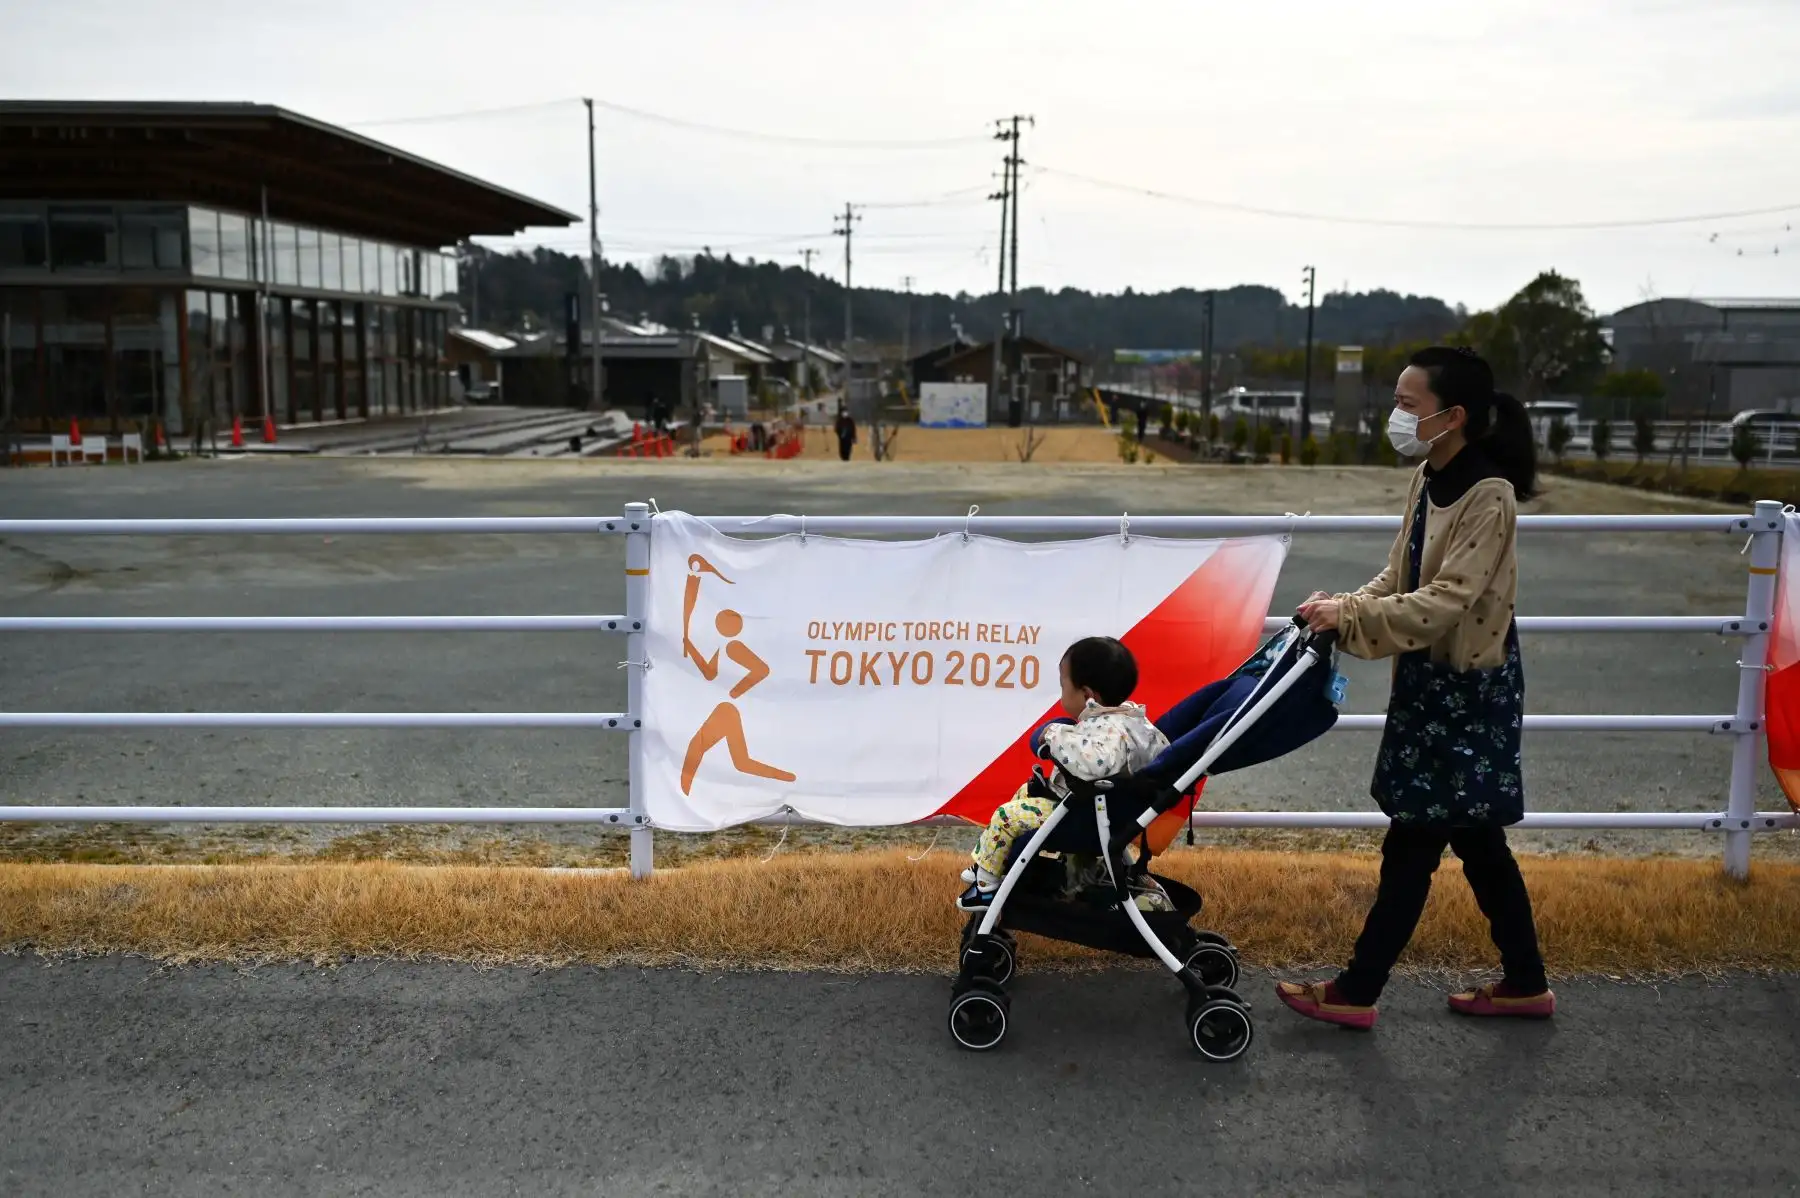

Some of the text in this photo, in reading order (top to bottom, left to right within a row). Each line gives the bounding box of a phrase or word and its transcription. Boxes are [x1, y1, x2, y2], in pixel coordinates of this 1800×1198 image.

[807, 621, 1041, 645] OLYMPIC TORCH RELAY
[805, 649, 1040, 690] TOKYO 2020
